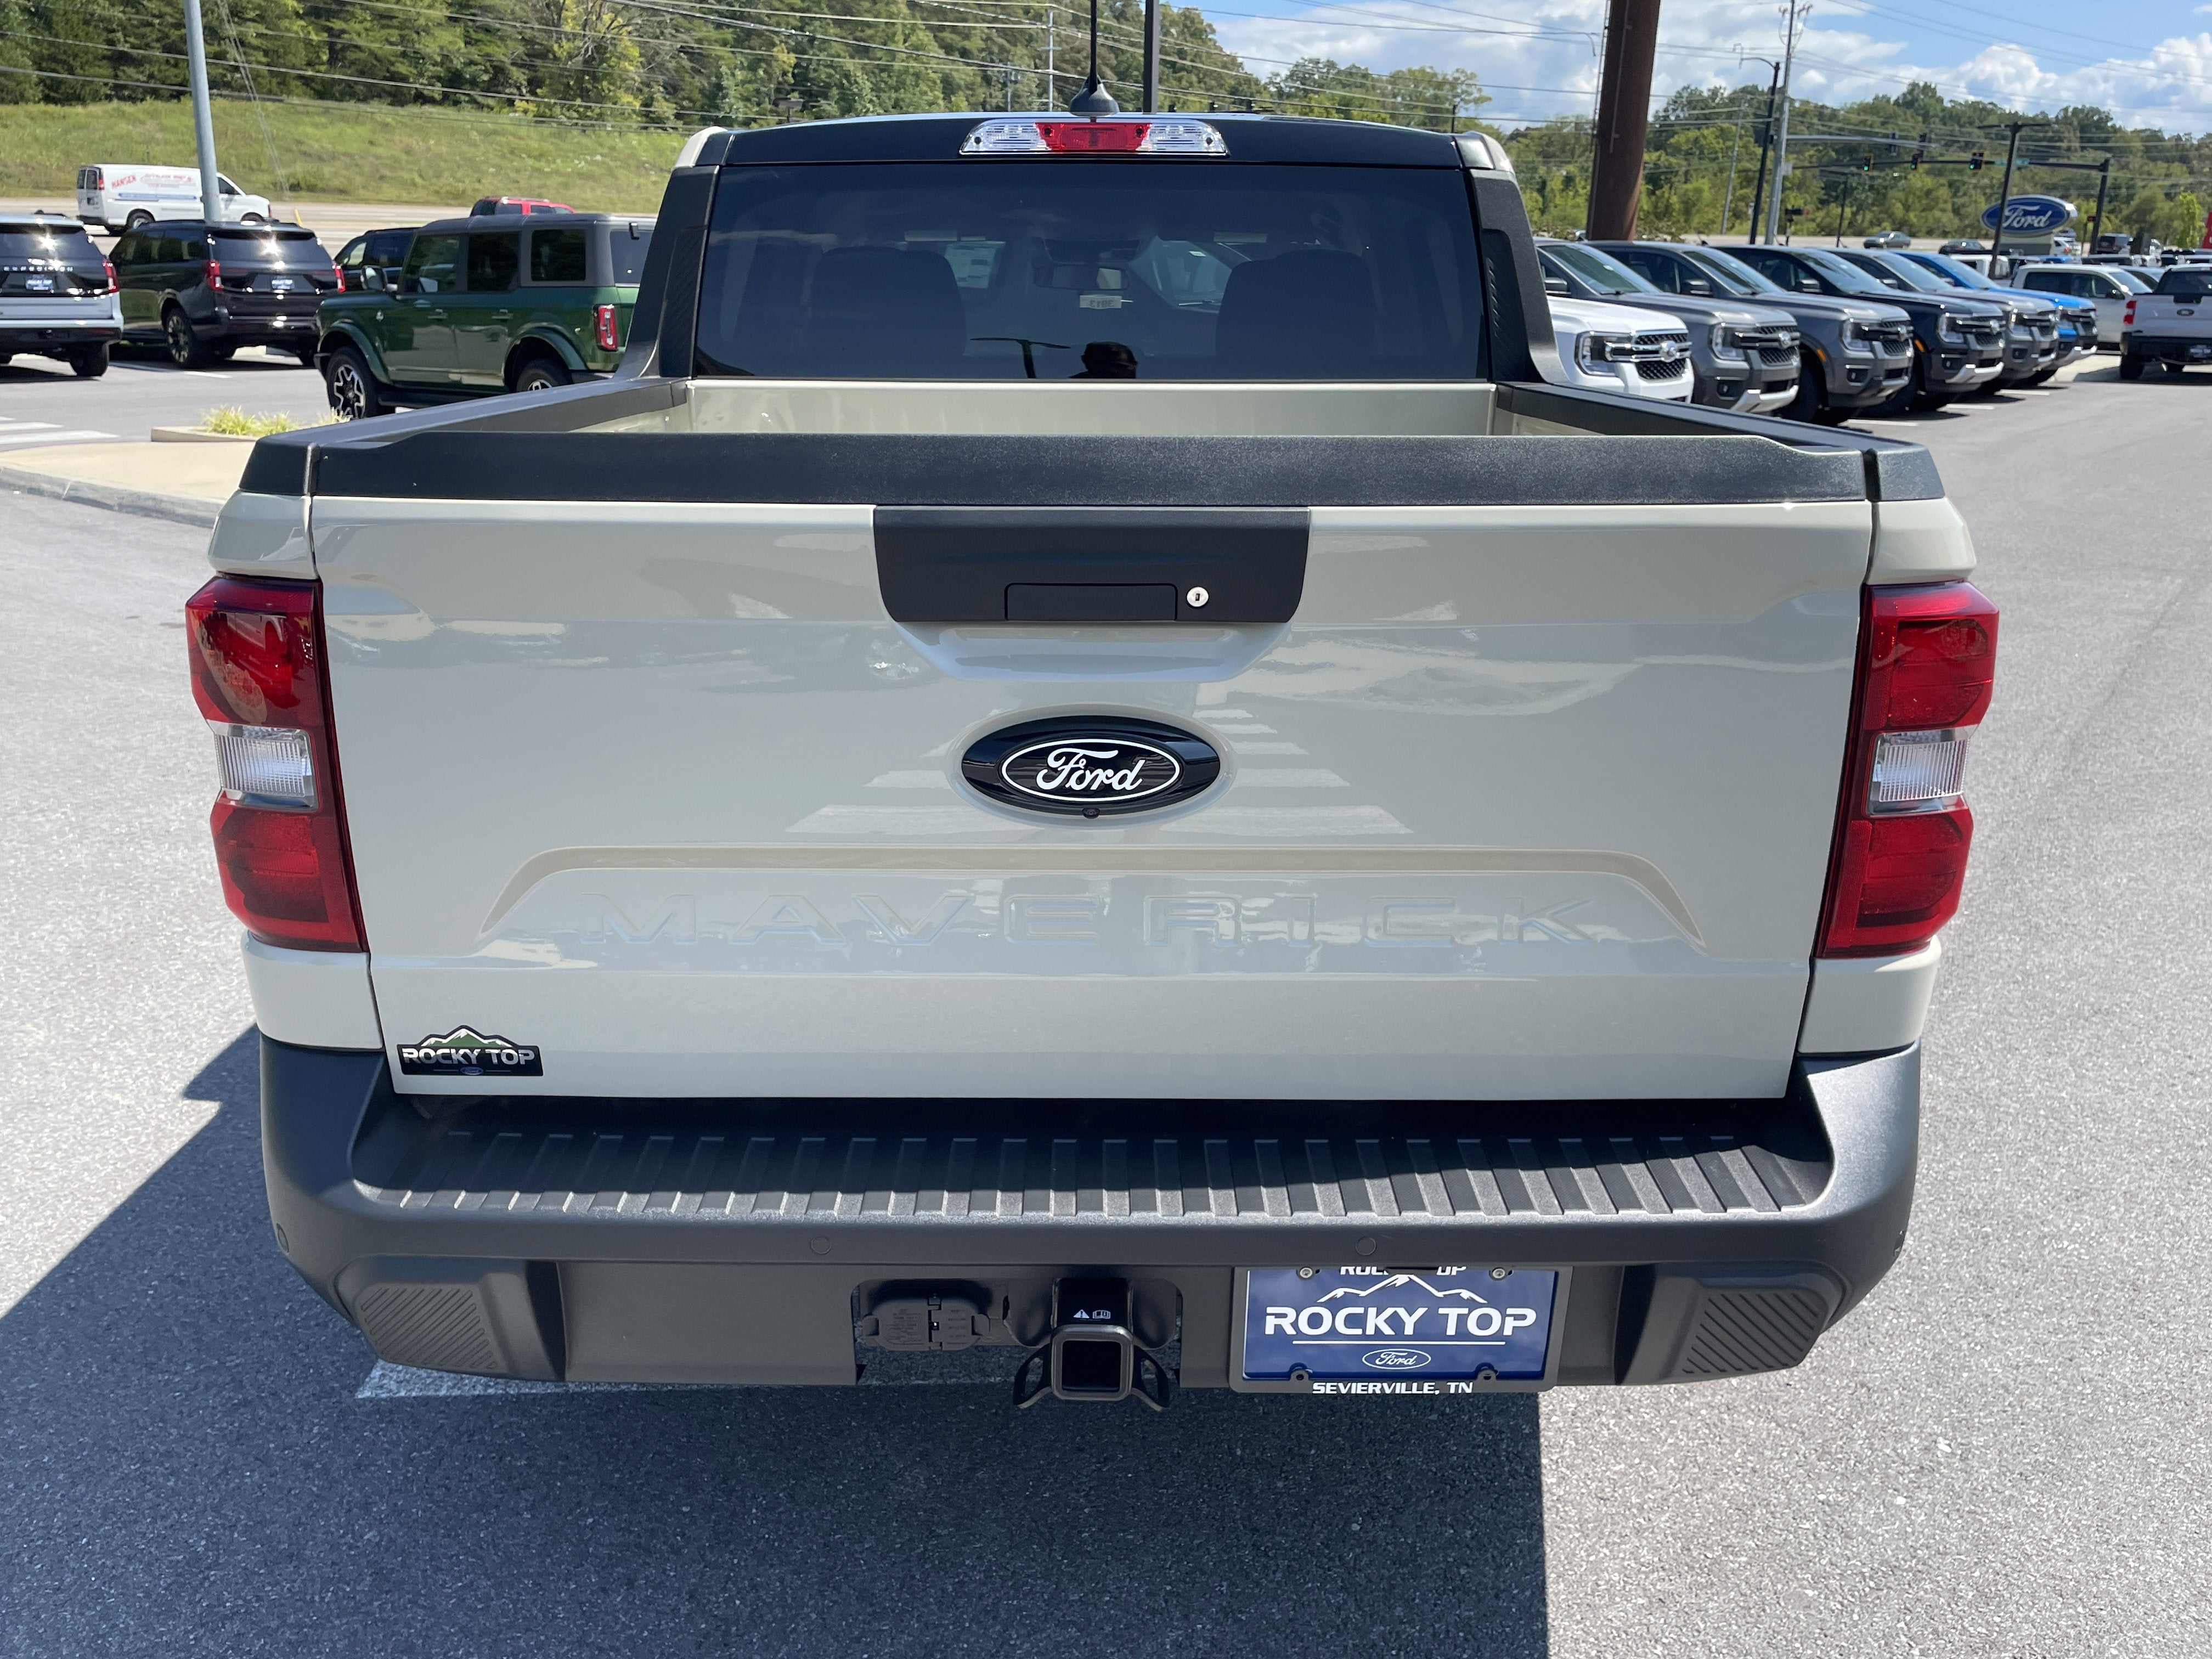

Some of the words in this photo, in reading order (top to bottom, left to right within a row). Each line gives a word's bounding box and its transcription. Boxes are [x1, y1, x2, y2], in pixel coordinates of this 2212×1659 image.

[2002, 205, 2052, 228] Ford
[1036, 748, 1145, 790] Ford
[580, 894, 1595, 945] MAVERICK
[402, 1048, 481, 1064] ROCKY
[486, 1049, 535, 1065] TOP
[1265, 1307, 1428, 1335] ROCKY
[1438, 1307, 1537, 1336] TOP
[1375, 1351, 1418, 1366] Ford
[1312, 1382, 1440, 1395] SEVIERVILLE,
[1447, 1383, 1474, 1394] TN
